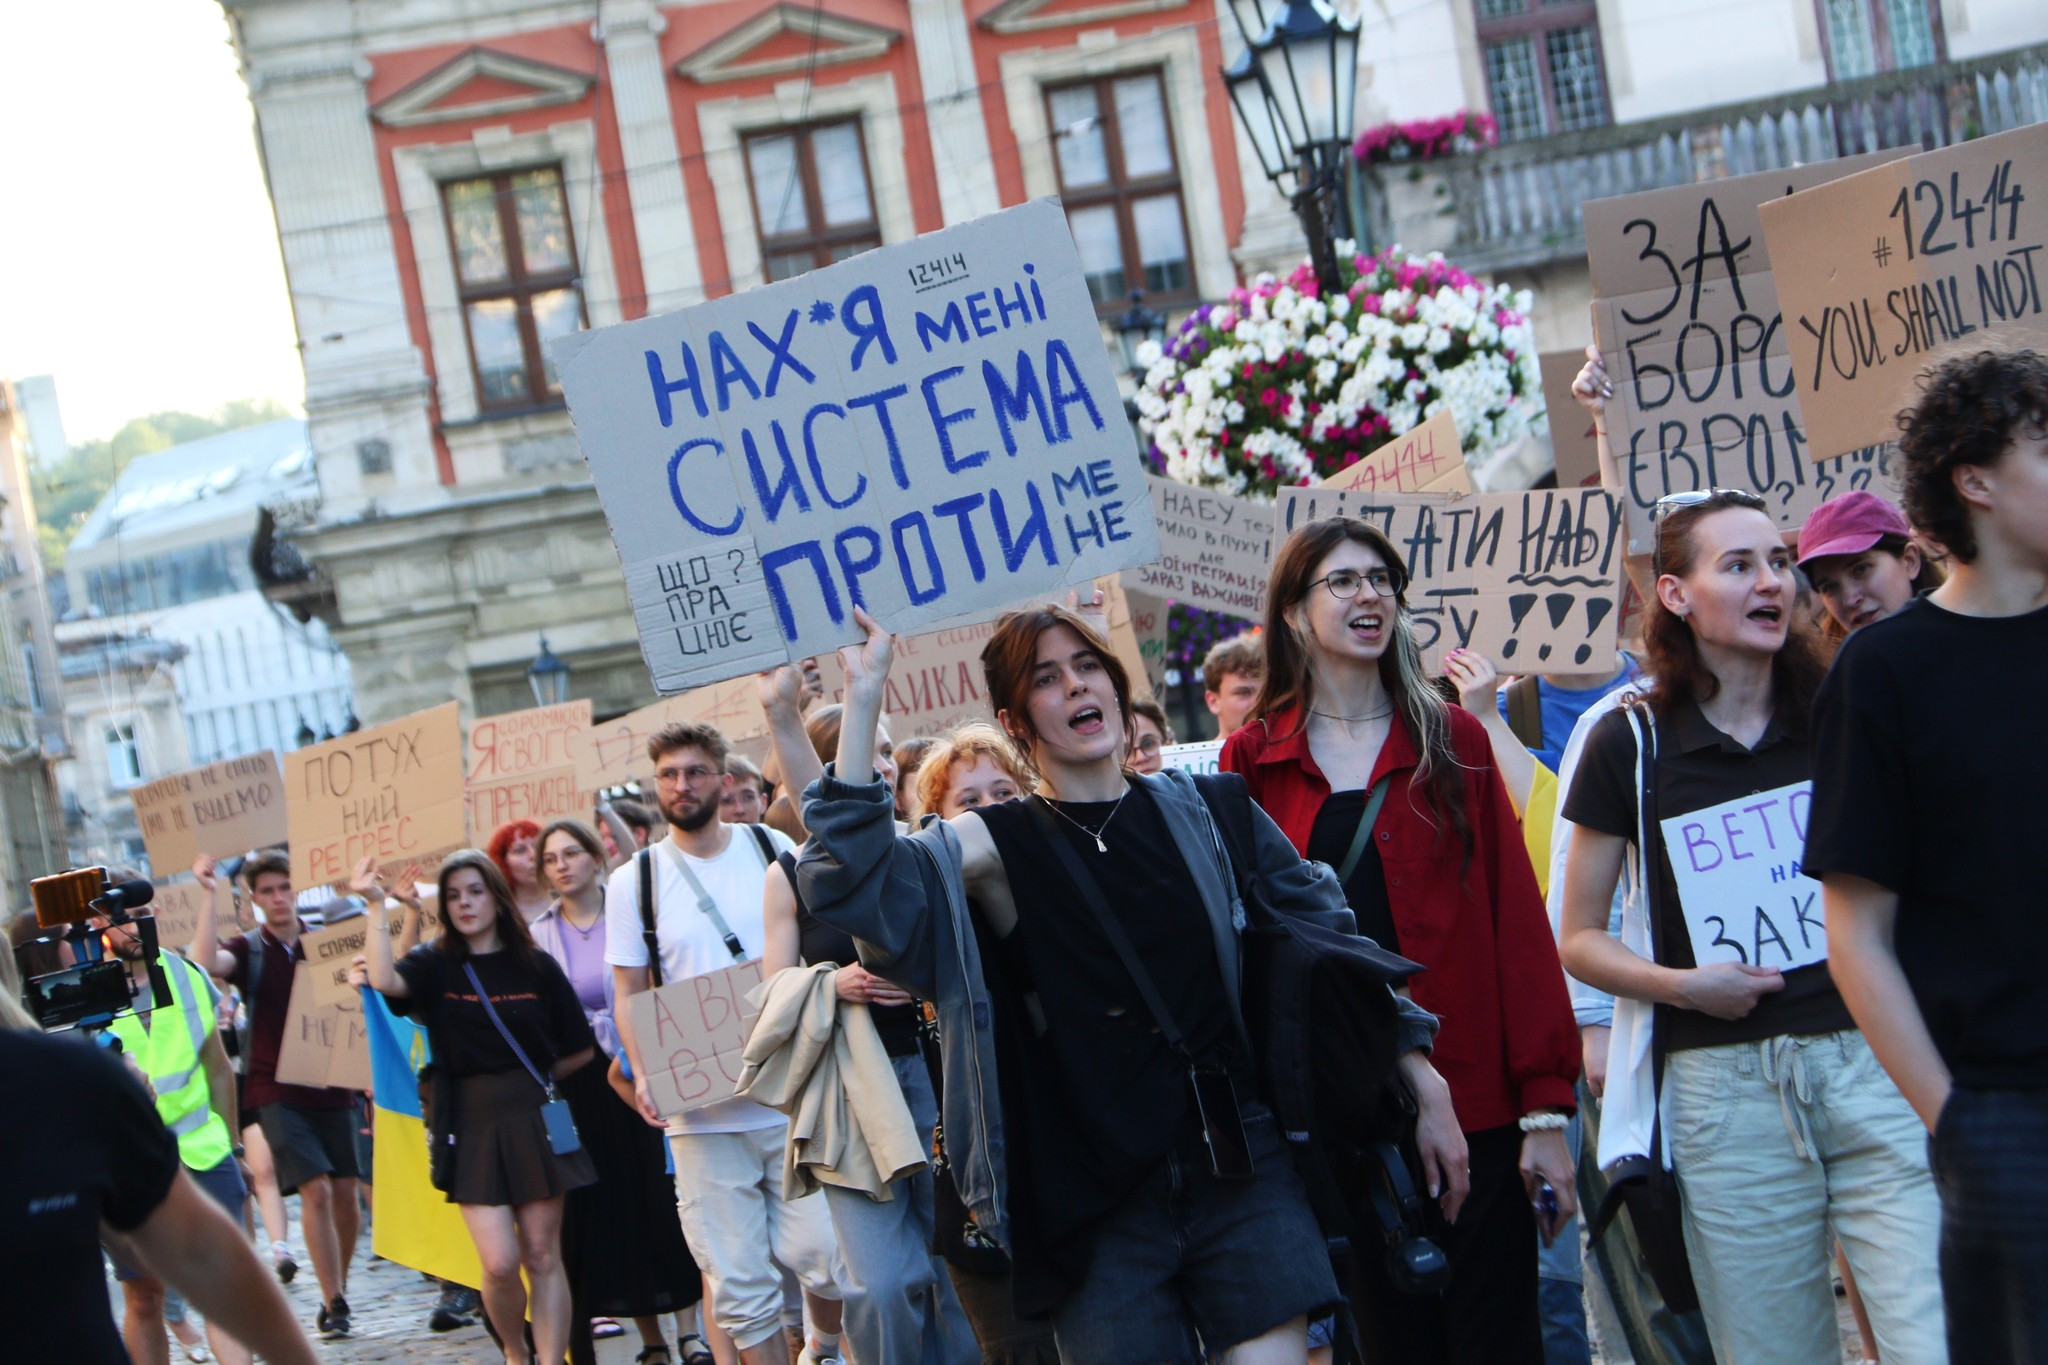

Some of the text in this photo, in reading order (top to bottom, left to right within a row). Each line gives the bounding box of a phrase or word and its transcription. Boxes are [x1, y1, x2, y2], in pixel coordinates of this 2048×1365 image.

[1872, 160, 2025, 268] #12414
[908, 252, 967, 286] 12414
[1621, 197, 1751, 325] ЗА
[1799, 244, 2043, 392] YOU SHALL NOT
[667, 339, 1105, 536] СИСТЕМА
[1052, 459, 1119, 507] МЕ
[1163, 487, 1235, 525] НАБУ
[1064, 501, 1132, 556] НЕ
[1519, 488, 1624, 577] НАБУ
[657, 549, 745, 593] ЩО ?
[761, 481, 1059, 642] ПРОТИ
[666, 585, 731, 622] ПРА
[676, 612, 753, 655] ЦЮЄ
[464, 722, 497, 781] Я
[193, 782, 271, 826] БУДЕМО
[342, 784, 399, 834] НИЙ
[309, 816, 418, 881] РЕГРЕС
